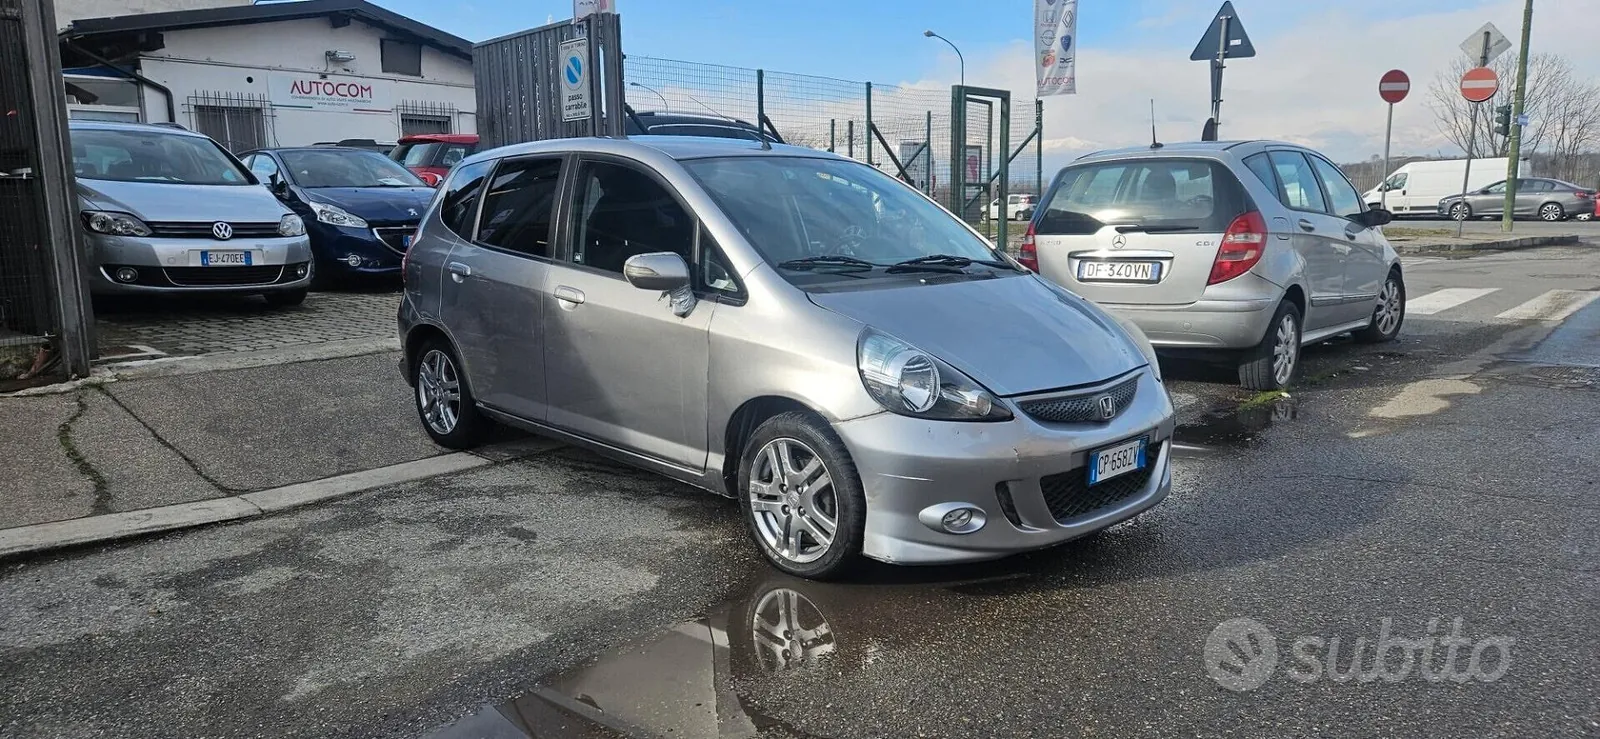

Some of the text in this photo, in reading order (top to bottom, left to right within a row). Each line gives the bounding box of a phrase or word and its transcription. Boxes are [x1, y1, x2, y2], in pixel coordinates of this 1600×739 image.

[290, 80, 372, 98] AUTOCOM
[568, 93, 583, 101] passo
[565, 102, 588, 111] carrabile
